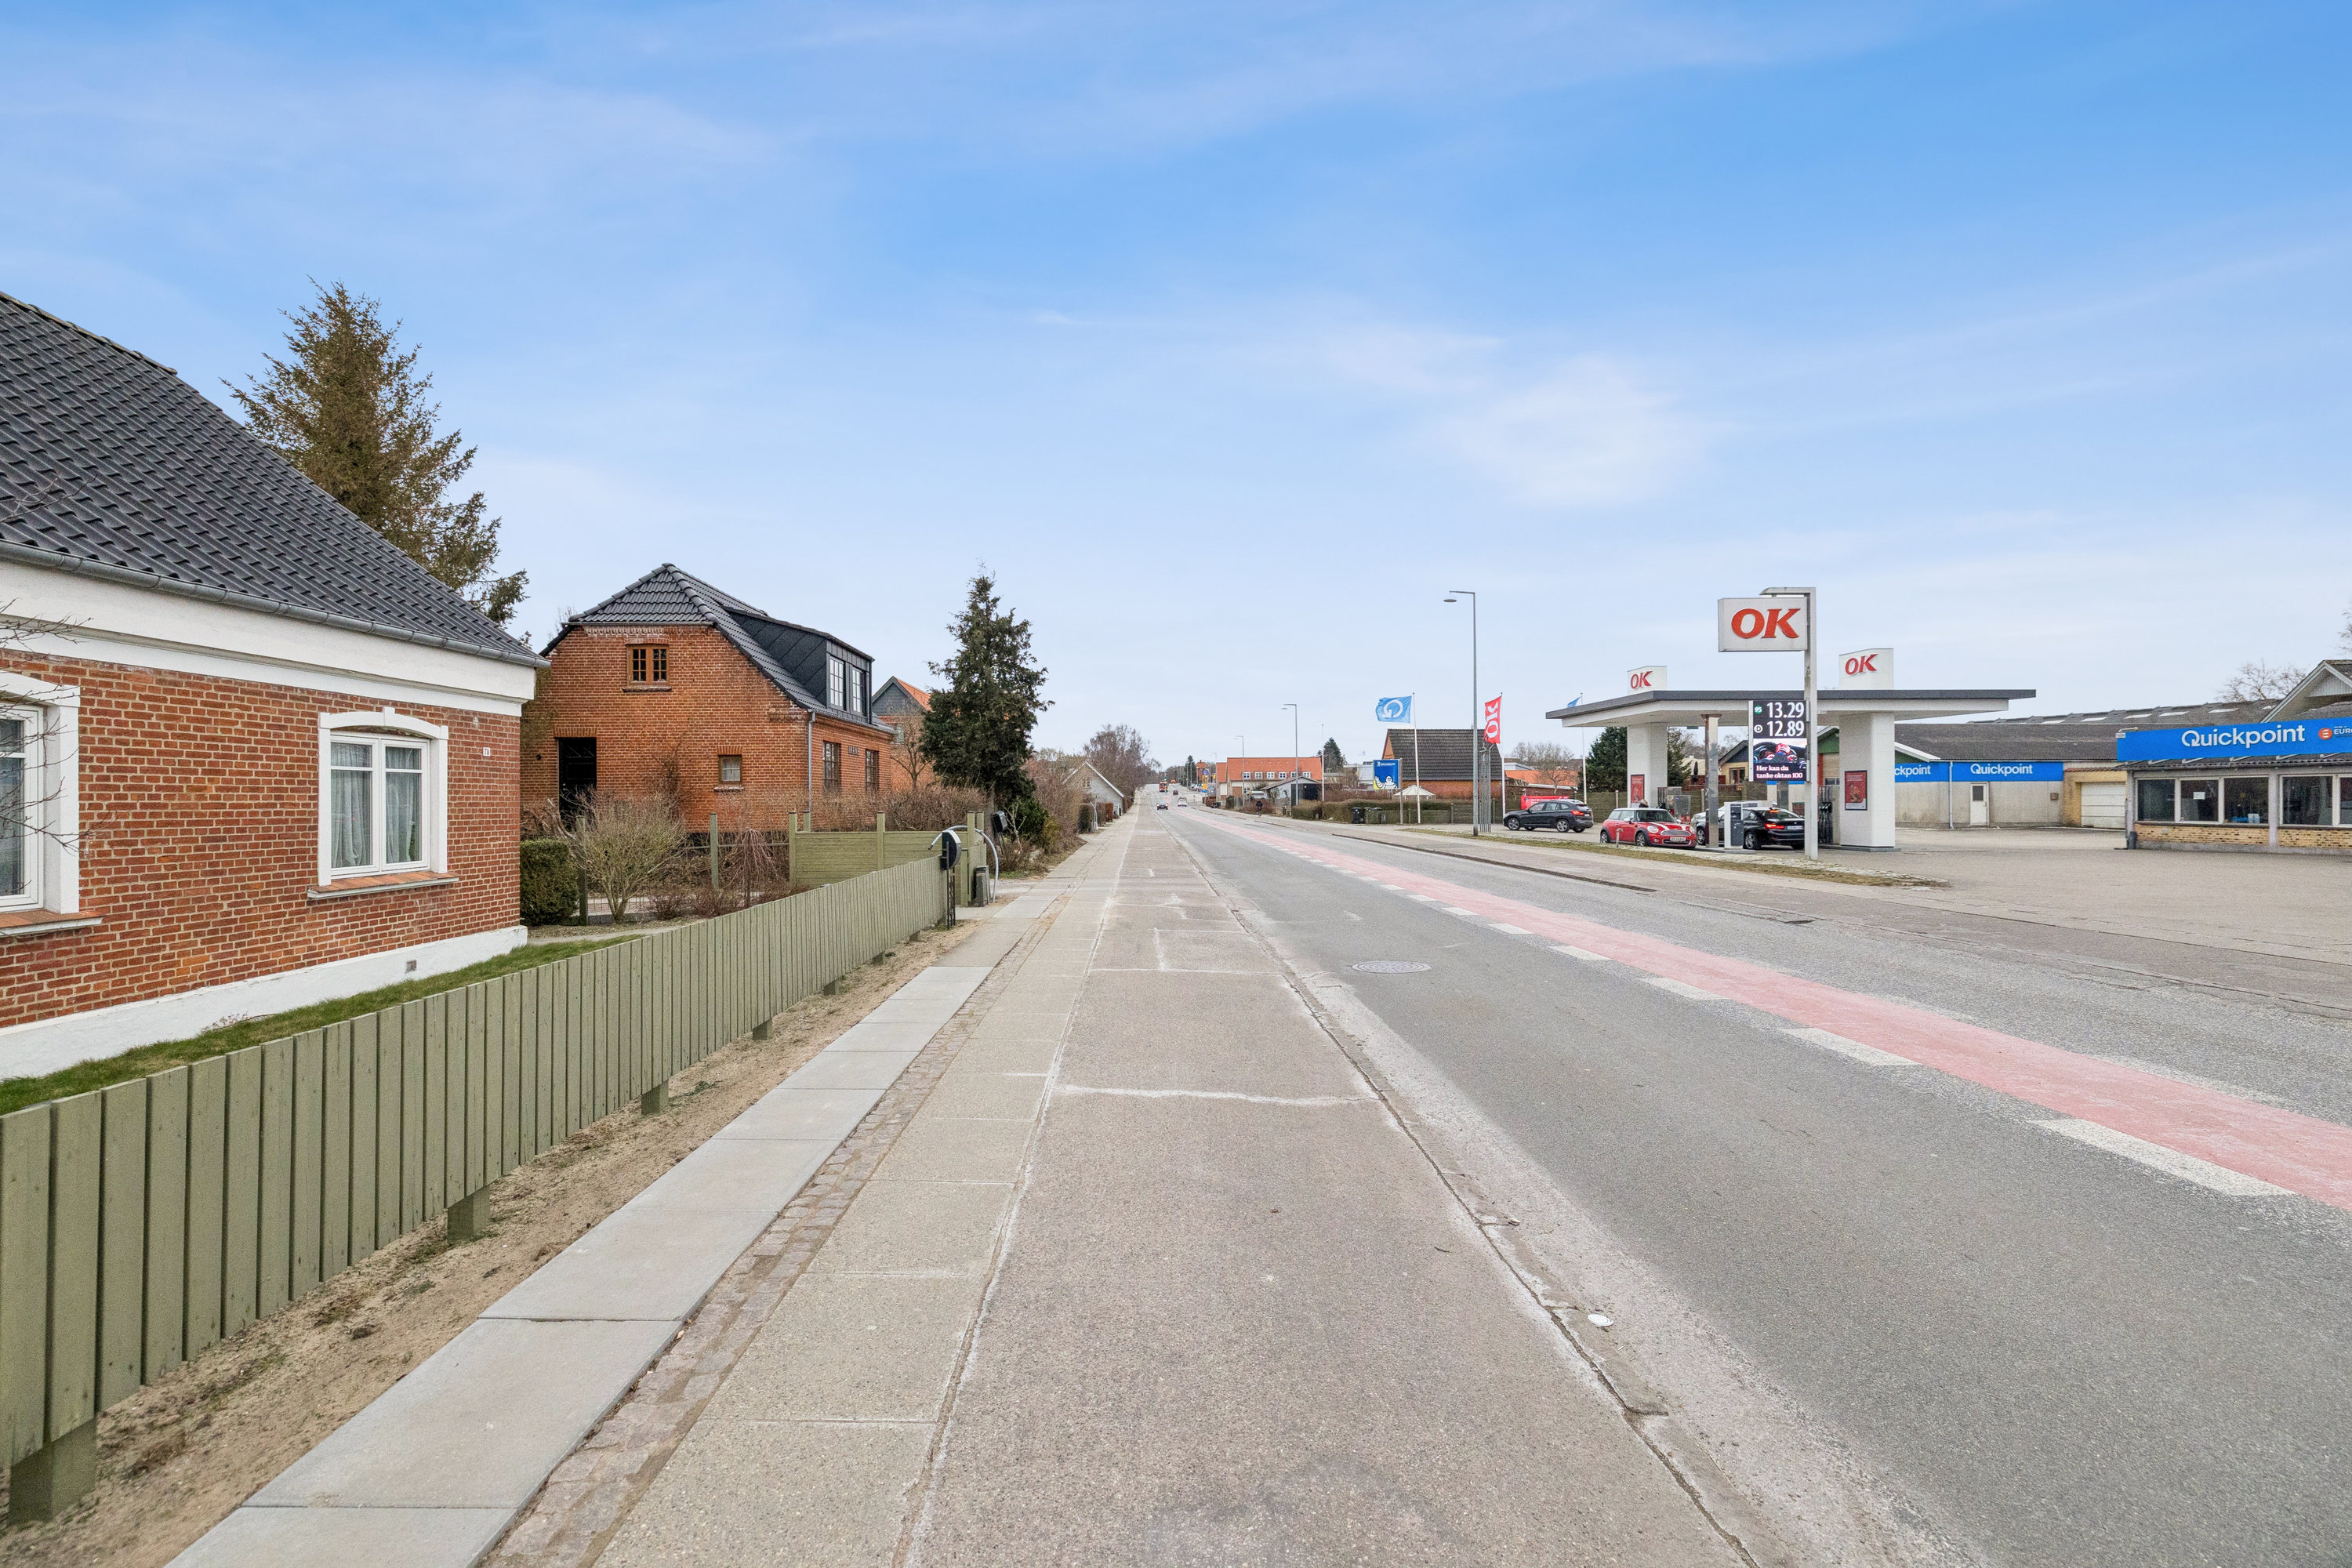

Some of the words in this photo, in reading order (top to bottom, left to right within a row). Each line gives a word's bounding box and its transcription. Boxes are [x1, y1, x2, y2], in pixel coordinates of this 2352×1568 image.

[1731, 608, 1801, 639] OK
[1845, 654, 1878, 675] OK
[1631, 671, 1653, 688] OK
[1766, 702, 1805, 718] 13.29
[1486, 702, 1498, 738] OK
[1766, 720, 1805, 737] 12.89
[2181, 724, 2305, 749] Quickpoint
[1970, 764, 2033, 776] Quickpoint
